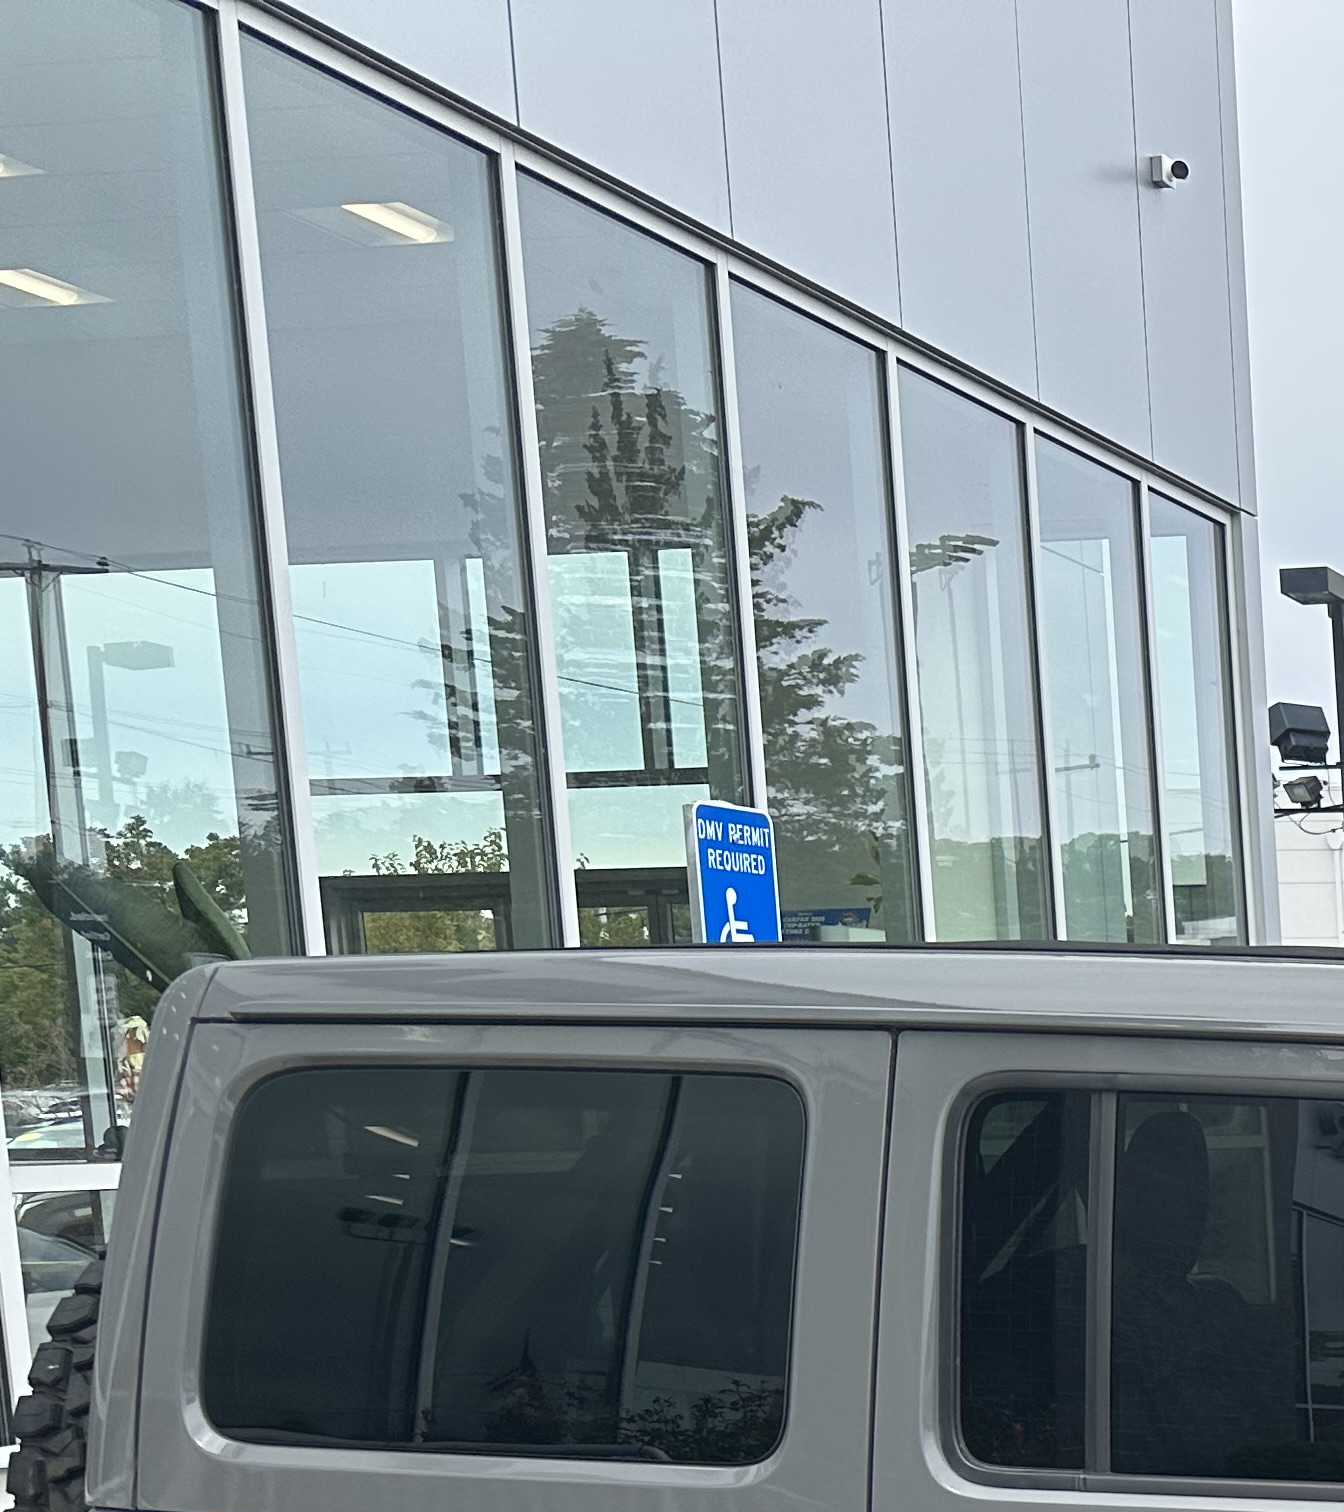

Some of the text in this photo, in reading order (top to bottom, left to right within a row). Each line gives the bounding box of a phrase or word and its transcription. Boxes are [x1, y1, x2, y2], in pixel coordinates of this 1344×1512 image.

[697, 818, 770, 848] DMV PERMIT
[707, 848, 766, 875] REQUIRED
